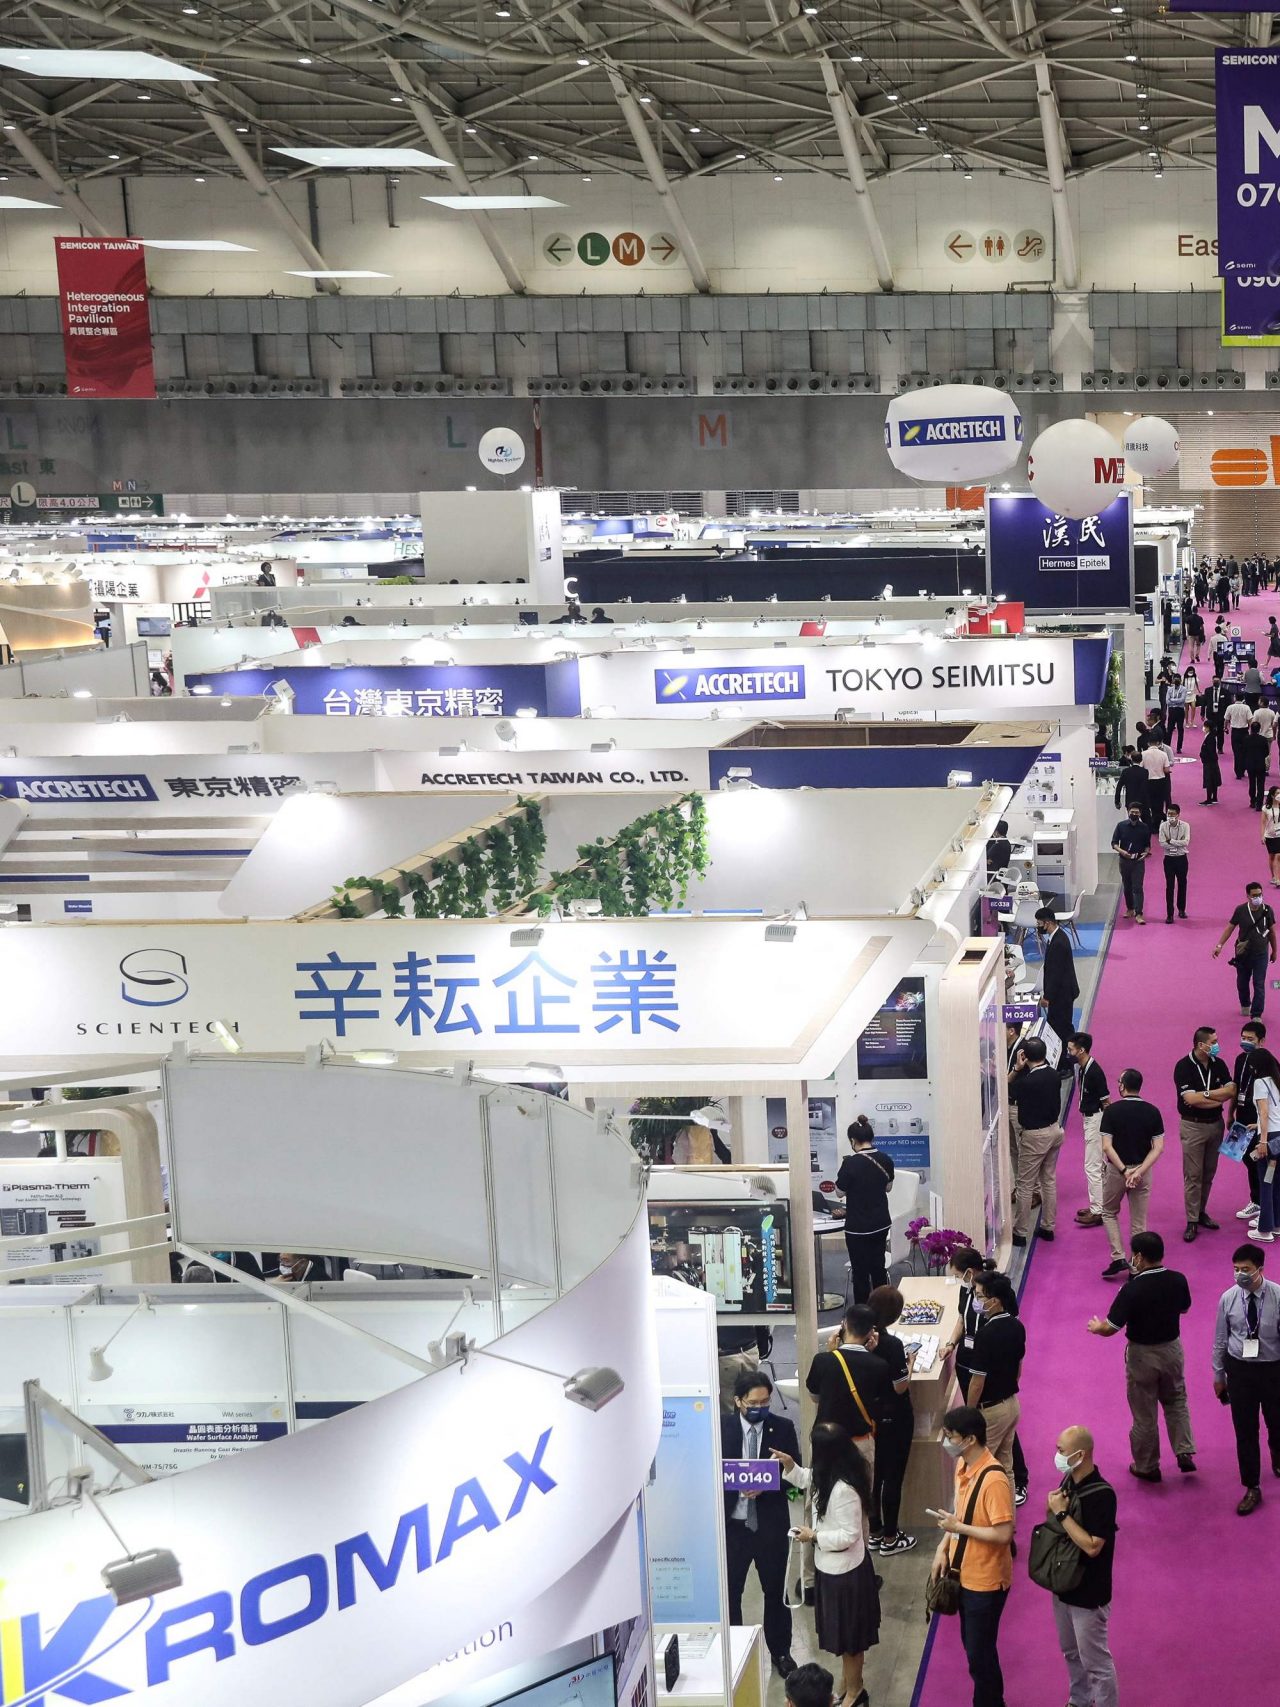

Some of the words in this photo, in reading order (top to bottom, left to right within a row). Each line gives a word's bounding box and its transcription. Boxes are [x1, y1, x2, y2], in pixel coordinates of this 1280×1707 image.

[1222, 55, 1276, 65] SEMICON
[60, 242, 101, 250] SEMICON
[103, 242, 139, 250] TAIWAN
[585, 237, 600, 259] L
[618, 237, 639, 260] M
[1177, 234, 1219, 256] Eas
[67, 291, 145, 302] Heterogeneous
[68, 303, 131, 314] Integration
[68, 313, 114, 324] Pavilion
[7, 417, 28, 449] L
[446, 415, 467, 448] L
[699, 414, 727, 446] M
[925, 420, 1001, 441] ACCRETECH
[0, 459, 29, 475] ast
[1041, 559, 1076, 568] Hermes
[1079, 559, 1107, 569] Epitek
[695, 671, 799, 697] ACCRETECH
[826, 667, 923, 692] TOKYO
[932, 662, 1055, 689] SEIMITSU
[323, 688, 503, 717] 台灣東京精密
[421, 773, 523, 785] ACCRETECH
[527, 772, 603, 784] TAIWAN
[609, 772, 645, 785] CO.,
[650, 771, 689, 783] LTD.
[16, 780, 148, 799] ACCRETECH
[295, 949, 681, 1037] 辛耘企業
[207, 1433, 232, 1441] Surface
[724, 1473, 735, 1483] M
[739, 1472, 773, 1483] 0140
